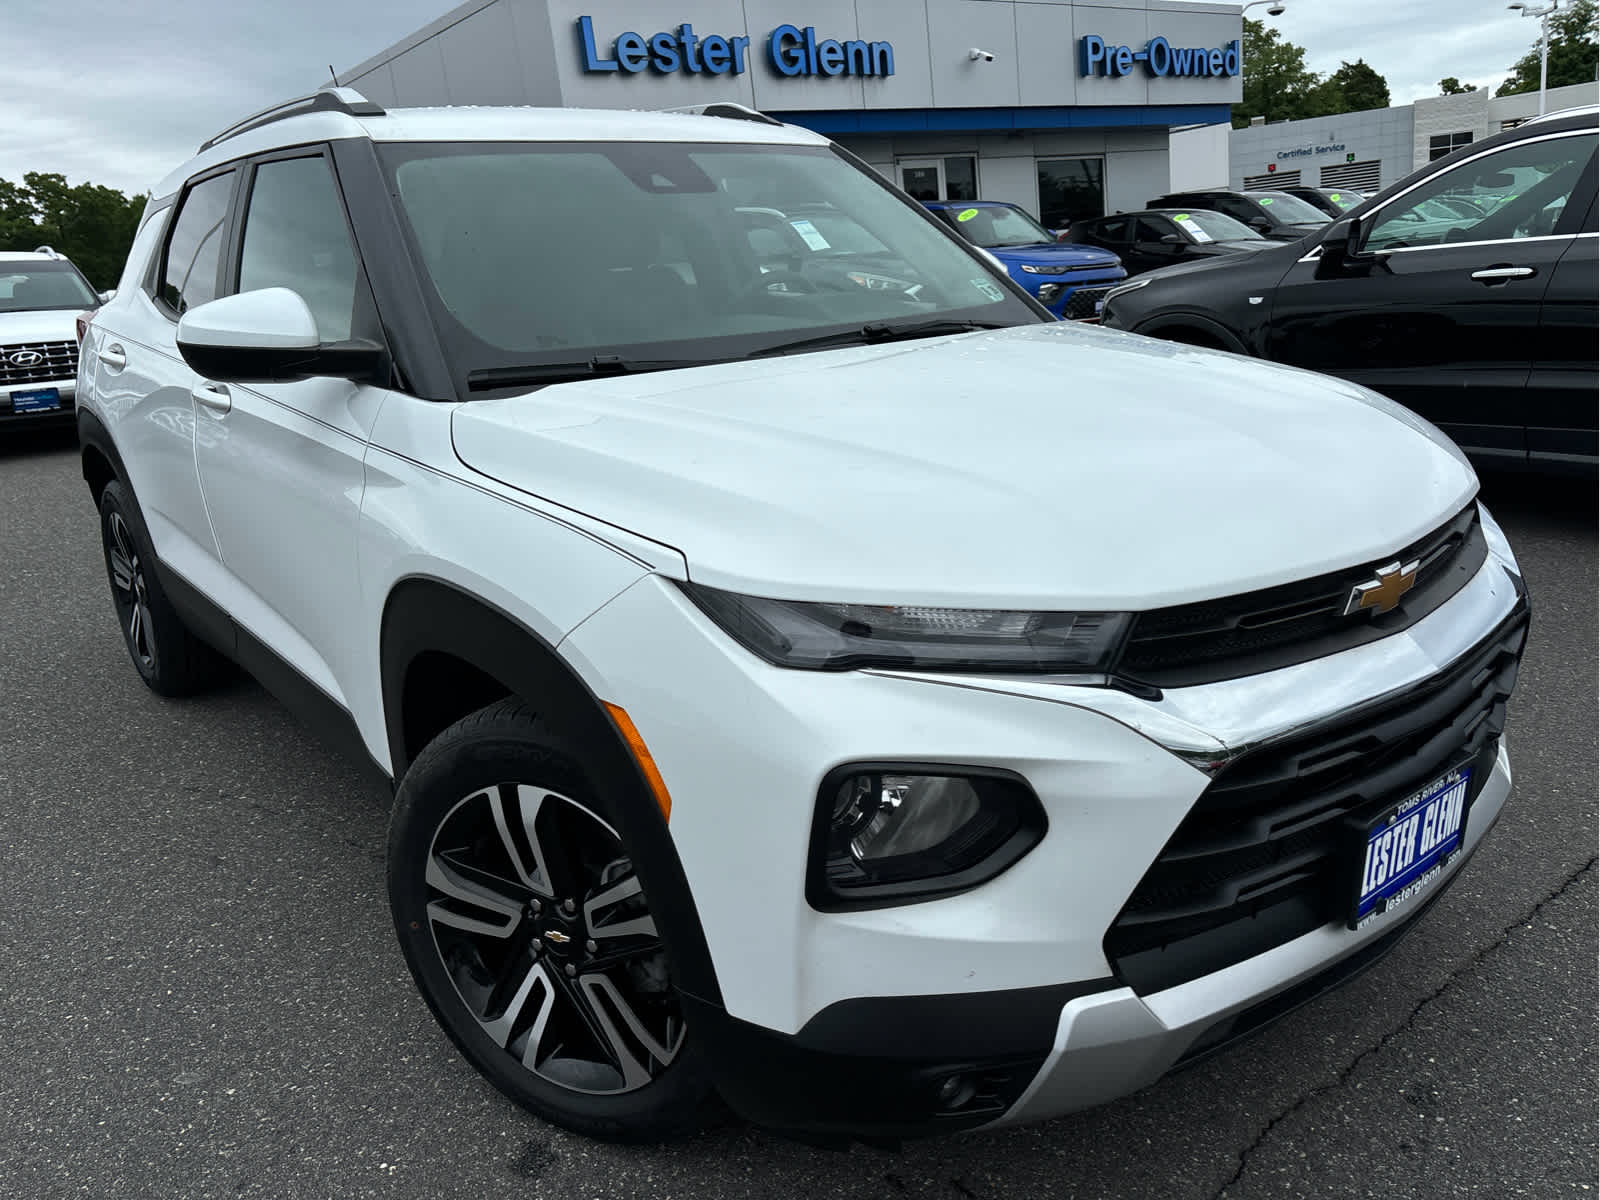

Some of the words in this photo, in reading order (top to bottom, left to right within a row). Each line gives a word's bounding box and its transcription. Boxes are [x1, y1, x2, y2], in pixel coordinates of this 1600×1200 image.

[577, 15, 749, 75] Lester
[767, 24, 895, 77] Glenn
[1080, 35, 1240, 78] Pre-Owned
[1276, 148, 1313, 160] Certified
[1315, 143, 1346, 155] Service
[1397, 794, 1421, 817] TOMS
[1361, 813, 1421, 898] LESTER
[1419, 780, 1468, 856] GLENN
